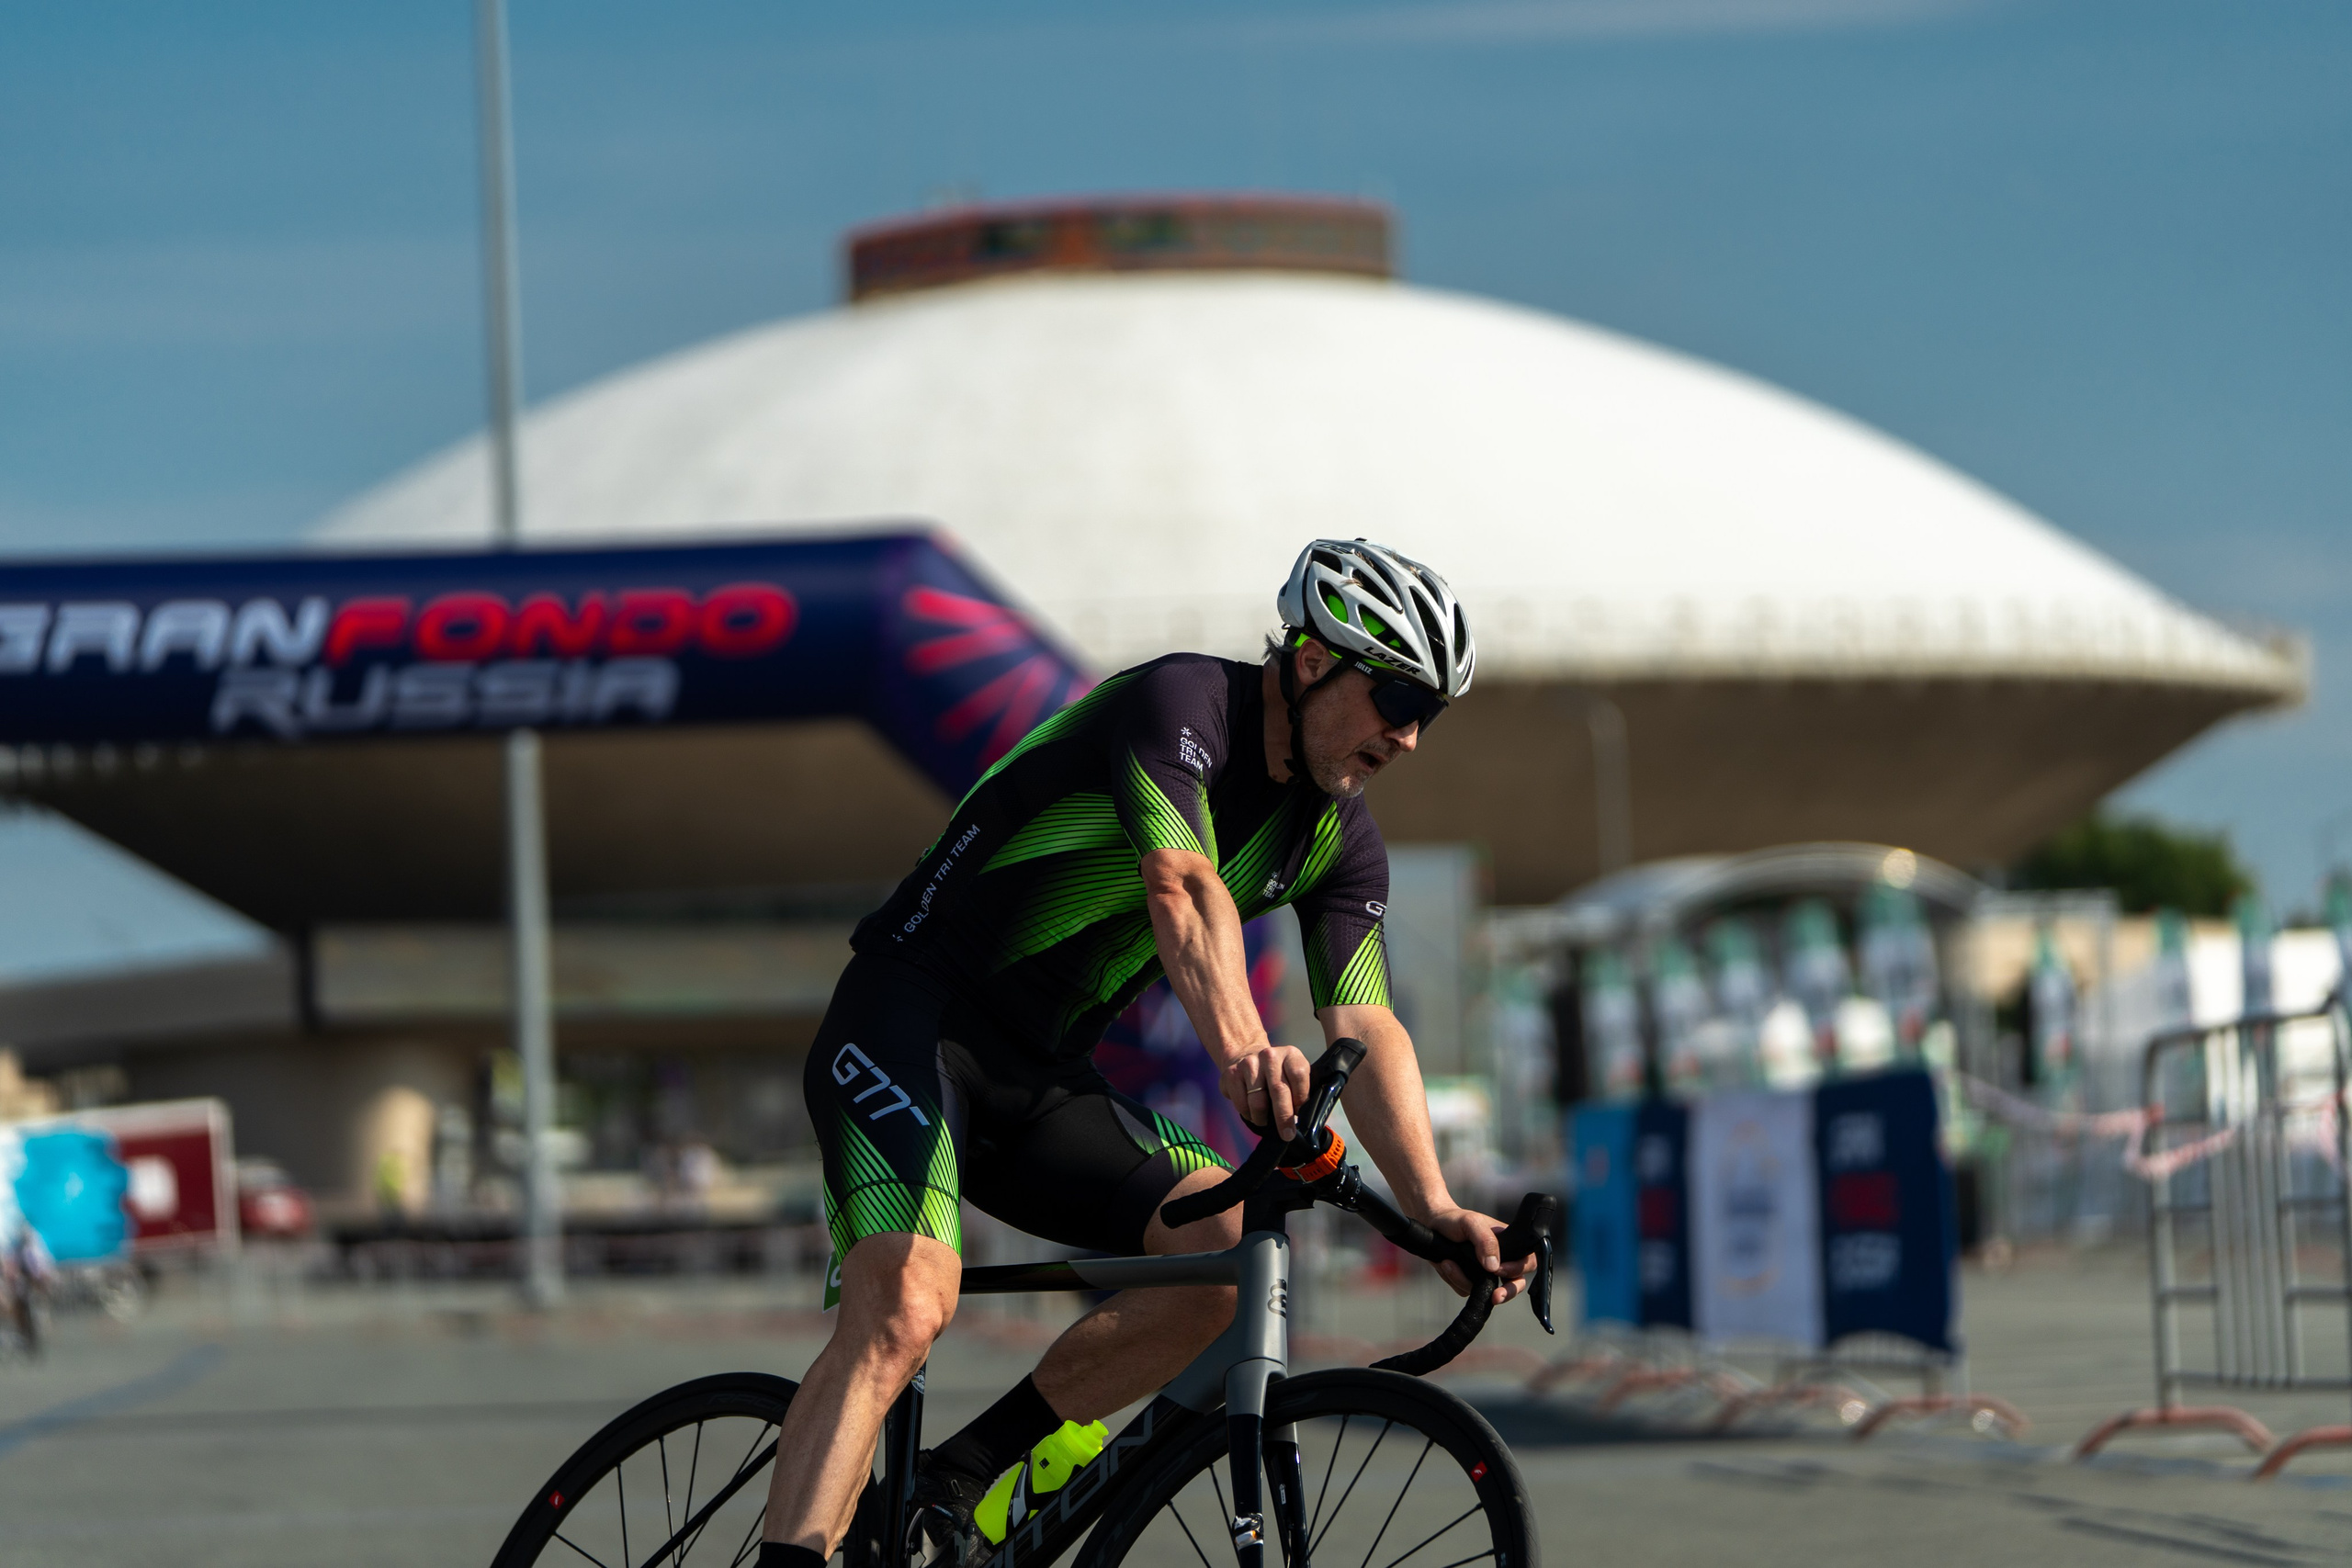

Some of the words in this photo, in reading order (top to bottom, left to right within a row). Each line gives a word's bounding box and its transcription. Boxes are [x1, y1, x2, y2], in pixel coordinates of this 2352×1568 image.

[1363, 646, 1421, 675] LAZER
[209, 659, 682, 738] RUSSIA
[1179, 751, 1204, 772] TEAM
[1180, 744, 1196, 758] TRI
[903, 882, 937, 932] GOLDEN
[934, 858, 954, 881] TRI
[950, 824, 981, 857] TEAM
